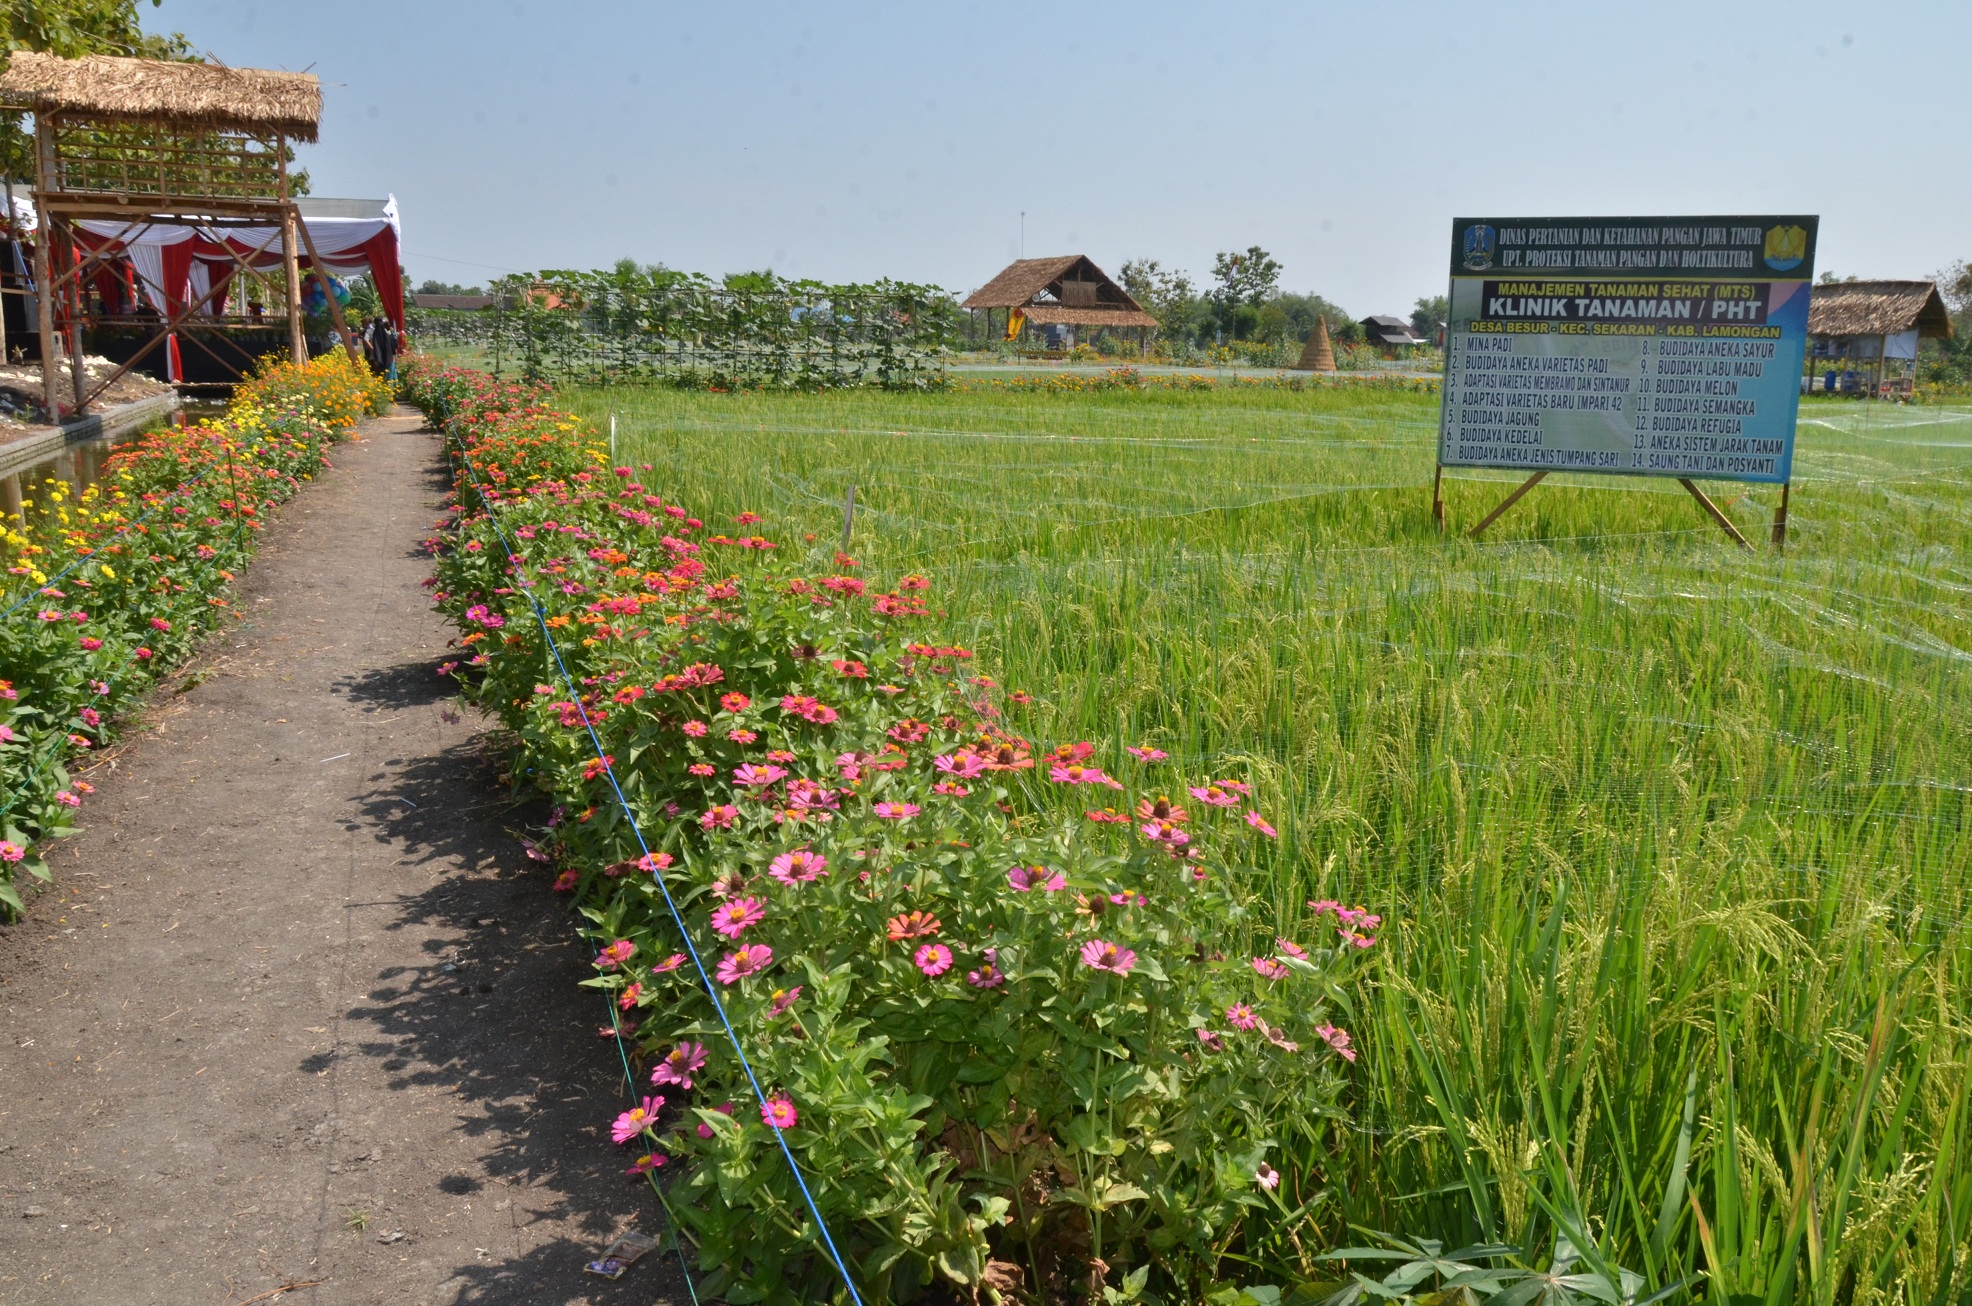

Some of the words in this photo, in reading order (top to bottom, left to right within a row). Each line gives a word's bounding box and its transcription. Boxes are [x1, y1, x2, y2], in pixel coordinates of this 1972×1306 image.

[1499, 228, 1526, 245] DINAS
[1529, 228, 1579, 245] PERTANIAN
[1582, 228, 1601, 245] DAN
[1603, 228, 1659, 245] KETAHANAN
[1661, 228, 1700, 245] PANGAN
[1702, 228, 1727, 247] JAWA
[1731, 228, 1762, 245] TIMUR
[1503, 250, 1522, 267] UPT.
[1525, 250, 1572, 267] PROTEKSI
[1575, 251, 1617, 267] TANAMAN
[1619, 250, 1657, 267] PANGAN
[1659, 250, 1680, 267] DAN
[1681, 250, 1753, 268] HOLTIKULTURA
[1498, 283, 1584, 296] MANAJEMEN
[1589, 284, 1658, 297] TANAMAN
[1662, 285, 1710, 298] SEHAT
[1714, 285, 1755, 300] (MTS)
[1489, 298, 1569, 316] KLINIK
[1575, 299, 1690, 318] TANAMAN
[1698, 301, 1705, 318] /
[1712, 301, 1761, 319] PHT
[1470, 321, 1504, 333] DESA
[1507, 322, 1549, 334] BESUR
[1560, 323, 1589, 334] KEC.
[1592, 324, 1655, 336] SEKARAN
[1667, 325, 1698, 337] KAB.
[1702, 326, 1781, 338] LAMONGAN
[1454, 337, 1460, 351] 1.
[1467, 337, 1489, 351] MINA
[1492, 338, 1512, 352] PADI
[1642, 341, 1649, 356] 8.
[1659, 341, 1705, 356] BUDIDAYA
[1707, 342, 1740, 357] ANEKA
[1743, 343, 1774, 358] SAYUR
[1452, 355, 1459, 369] 2.
[1465, 355, 1507, 370] BUDIDAYA
[1510, 357, 1539, 371] ANEKA
[1542, 358, 1584, 372] VARIETAS
[1587, 359, 1608, 373] PADI
[1641, 359, 1648, 374] 9.
[1658, 360, 1703, 375] BUDIDAYA
[1706, 361, 1731, 376] LABU
[1734, 362, 1762, 377] MADU
[1450, 374, 1457, 387] 3.
[1464, 374, 1497, 389] ADAPTASI
[1498, 375, 1532, 389] VARIETAS
[1533, 376, 1576, 391] MEMBRAMO
[1577, 377, 1591, 391] DAN
[1593, 378, 1629, 392] SINTANUR
[1639, 378, 1651, 393] 10.
[1656, 379, 1701, 394] BUDIDAYA
[1704, 380, 1738, 395] MELON
[1449, 392, 1456, 405] 4.
[1462, 392, 1504, 407] ADAPTASI
[1506, 394, 1548, 408] VARIETAS
[1551, 395, 1574, 409] BARU
[1577, 395, 1609, 410] IMPARI
[1611, 396, 1622, 411] 42
[1637, 397, 1649, 411] 11.
[1654, 398, 1699, 413] BUDIDAYA
[1702, 399, 1755, 415] SEMANGKA
[1448, 410, 1455, 423] 5.
[1461, 410, 1504, 425] BUDIDAYA
[1505, 411, 1540, 426] JAGUNG
[1635, 416, 1648, 430] 12.
[1652, 416, 1697, 432] BUDIDAYA
[1700, 418, 1741, 434] REFUGIA
[1447, 428, 1453, 441] 6.
[1460, 428, 1502, 443] BUDIDAYA
[1505, 430, 1542, 445] KEDELAI
[1634, 435, 1646, 449] 13.
[1650, 436, 1681, 450] ANEKA
[1684, 437, 1718, 452] SISTEM
[1719, 438, 1750, 453] JARAK
[1752, 439, 1783, 454] TANAM
[1446, 445, 1452, 459] 7.
[1459, 446, 1498, 460] BUDIDAYA
[1500, 448, 1528, 462] ANEKA
[1530, 449, 1556, 463] JENIS
[1557, 450, 1596, 465] TUMPANG
[1598, 452, 1619, 466] SARI
[1632, 453, 1644, 467] 14.
[1648, 454, 1679, 469] SAUNG
[1681, 455, 1703, 470] TANI
[1706, 456, 1726, 471] DAN
[1727, 457, 1774, 473] POSYANTI
